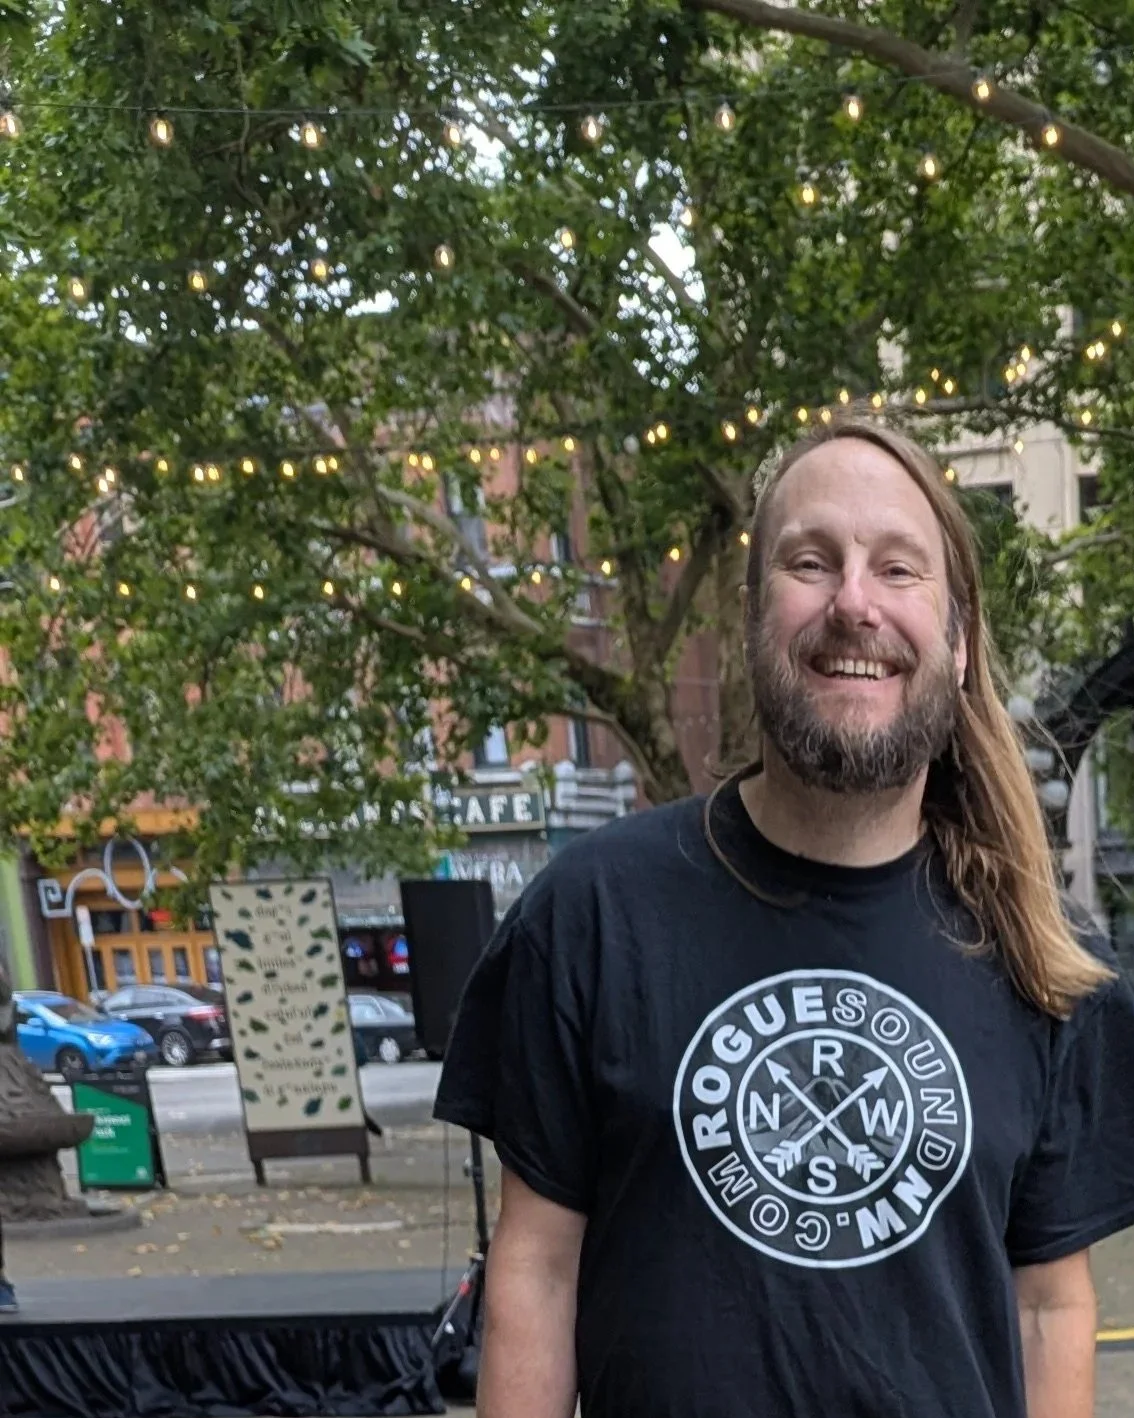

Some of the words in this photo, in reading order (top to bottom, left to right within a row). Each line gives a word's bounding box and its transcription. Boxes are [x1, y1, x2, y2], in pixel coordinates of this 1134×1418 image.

[812, 1039, 844, 1077] R
[749, 1091, 780, 1131] N
[858, 1098, 904, 1137] W
[807, 1156, 837, 1195] S
